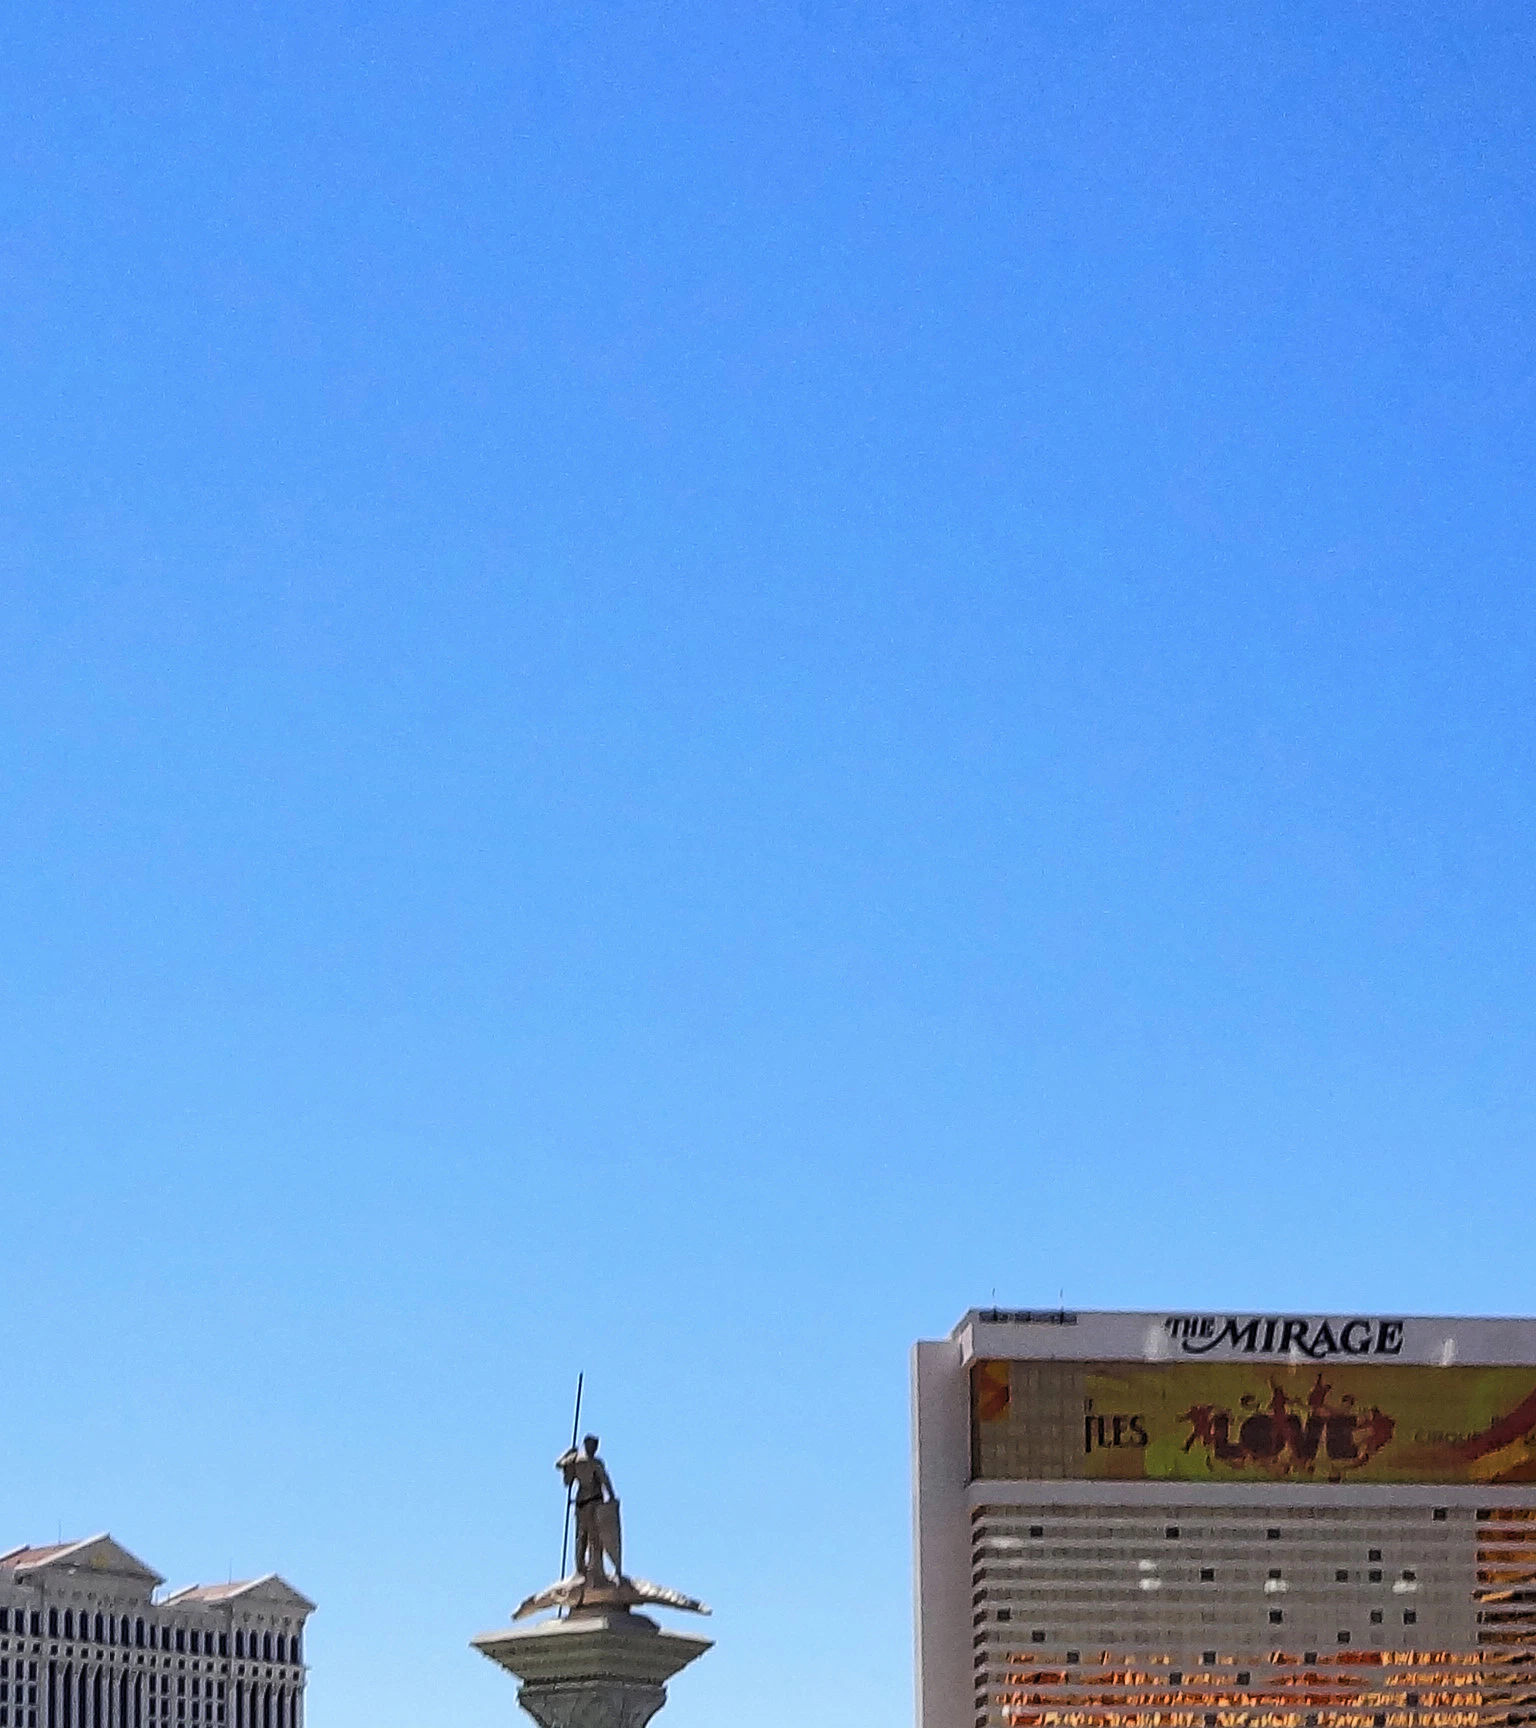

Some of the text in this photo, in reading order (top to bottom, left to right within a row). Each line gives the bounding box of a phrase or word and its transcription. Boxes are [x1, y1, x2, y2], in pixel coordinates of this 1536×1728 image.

[1166, 1316, 1404, 1358] THE MIRAGE
[1213, 1411, 1359, 1459] LOVE
